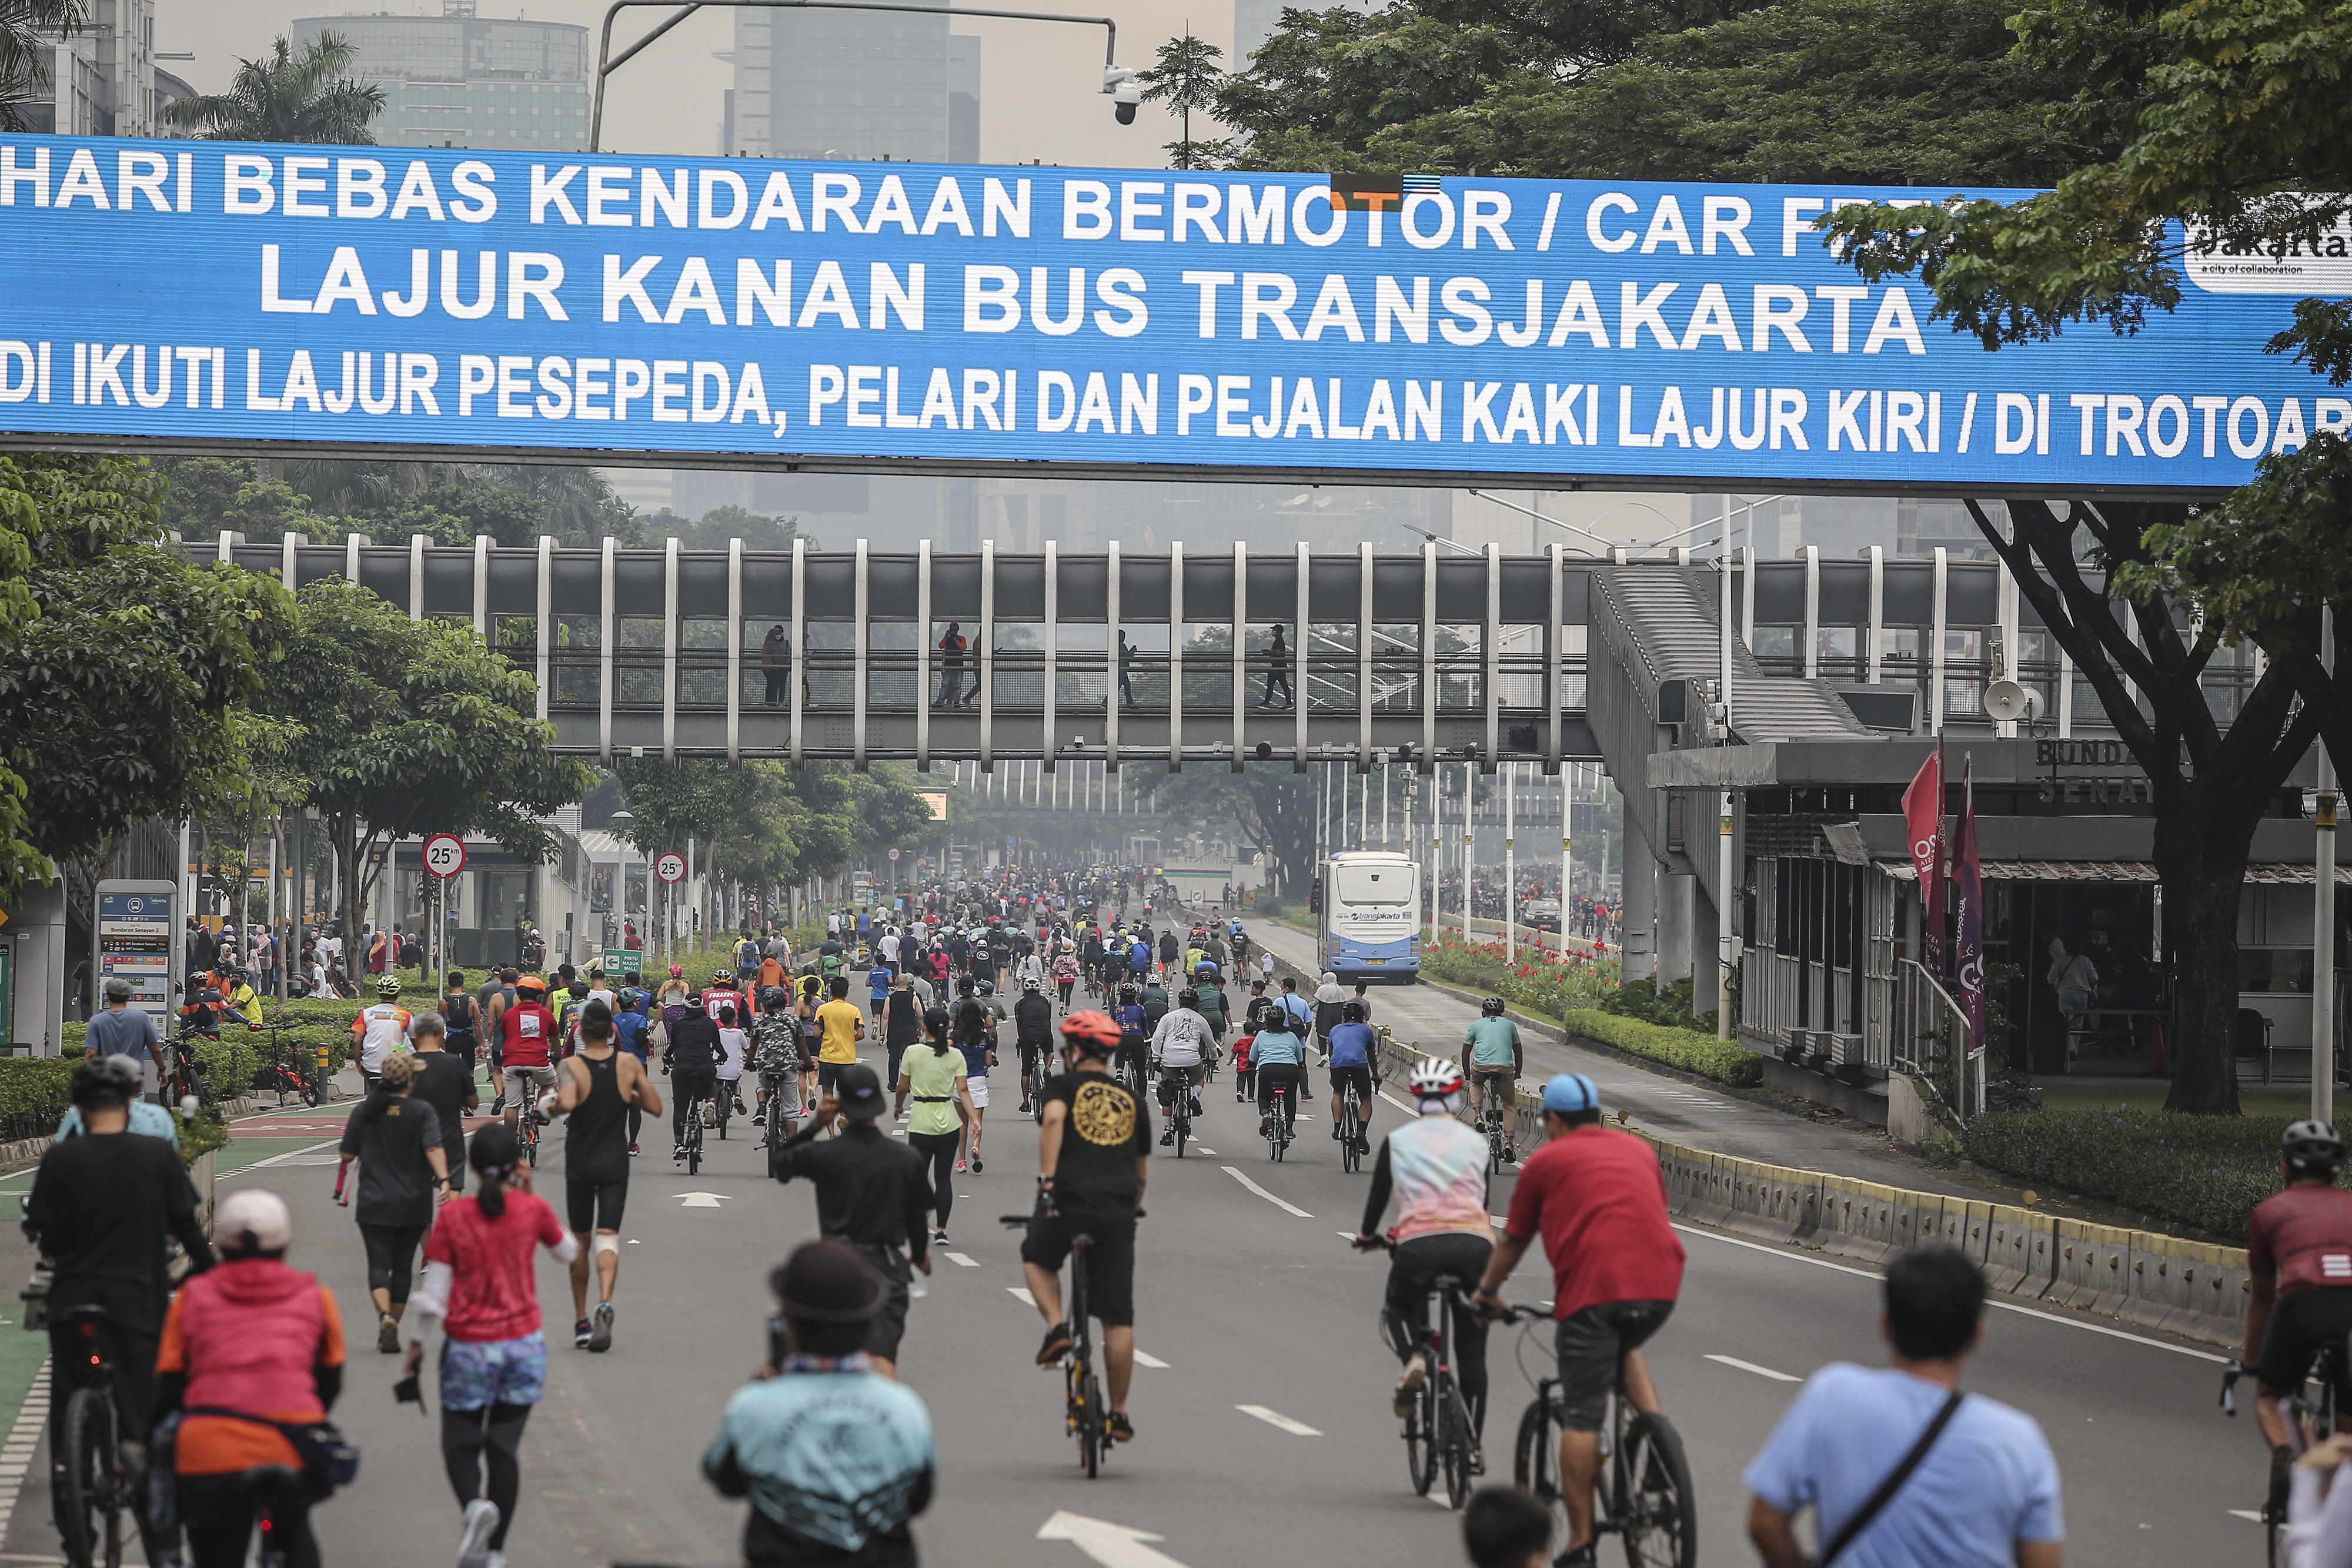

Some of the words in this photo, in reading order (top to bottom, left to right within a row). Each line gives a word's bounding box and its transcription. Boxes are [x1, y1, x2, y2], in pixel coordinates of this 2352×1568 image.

[0, 145, 192, 213] HARI
[223, 153, 499, 224] BEBAS
[529, 163, 1031, 239] KENDARAAN
[1062, 179, 1516, 251] BERMOTOR
[1536, 192, 1563, 252] /
[1586, 192, 1756, 258] CAR
[2210, 264, 2226, 275] city
[2229, 264, 2239, 273] of
[2240, 264, 2303, 273] collaboration
[260, 243, 570, 321] LAJUR
[602, 253, 926, 331] KANAN
[963, 264, 1148, 339] BUS
[1182, 270, 1927, 355] TRANSJAKARTA
[0, 340, 51, 404] DI
[72, 342, 225, 409] IKUTI
[246, 348, 442, 416] LAJUR
[459, 353, 787, 439] PESEPEDA,
[808, 363, 1017, 432] PELARI
[1037, 370, 1159, 436] DAN
[1177, 375, 1442, 443] PEJALAN
[1462, 380, 1599, 446] KAKI
[1619, 385, 1811, 451] LAJUR
[1828, 389, 1941, 453] KIRI
[1957, 392, 1978, 454] /
[1995, 393, 2050, 456] DI
[431, 847, 450, 864] 25
[662, 863, 676, 874] 25
[841, 917, 846, 925] 8
[1358, 912, 1401, 921] transjakarta
